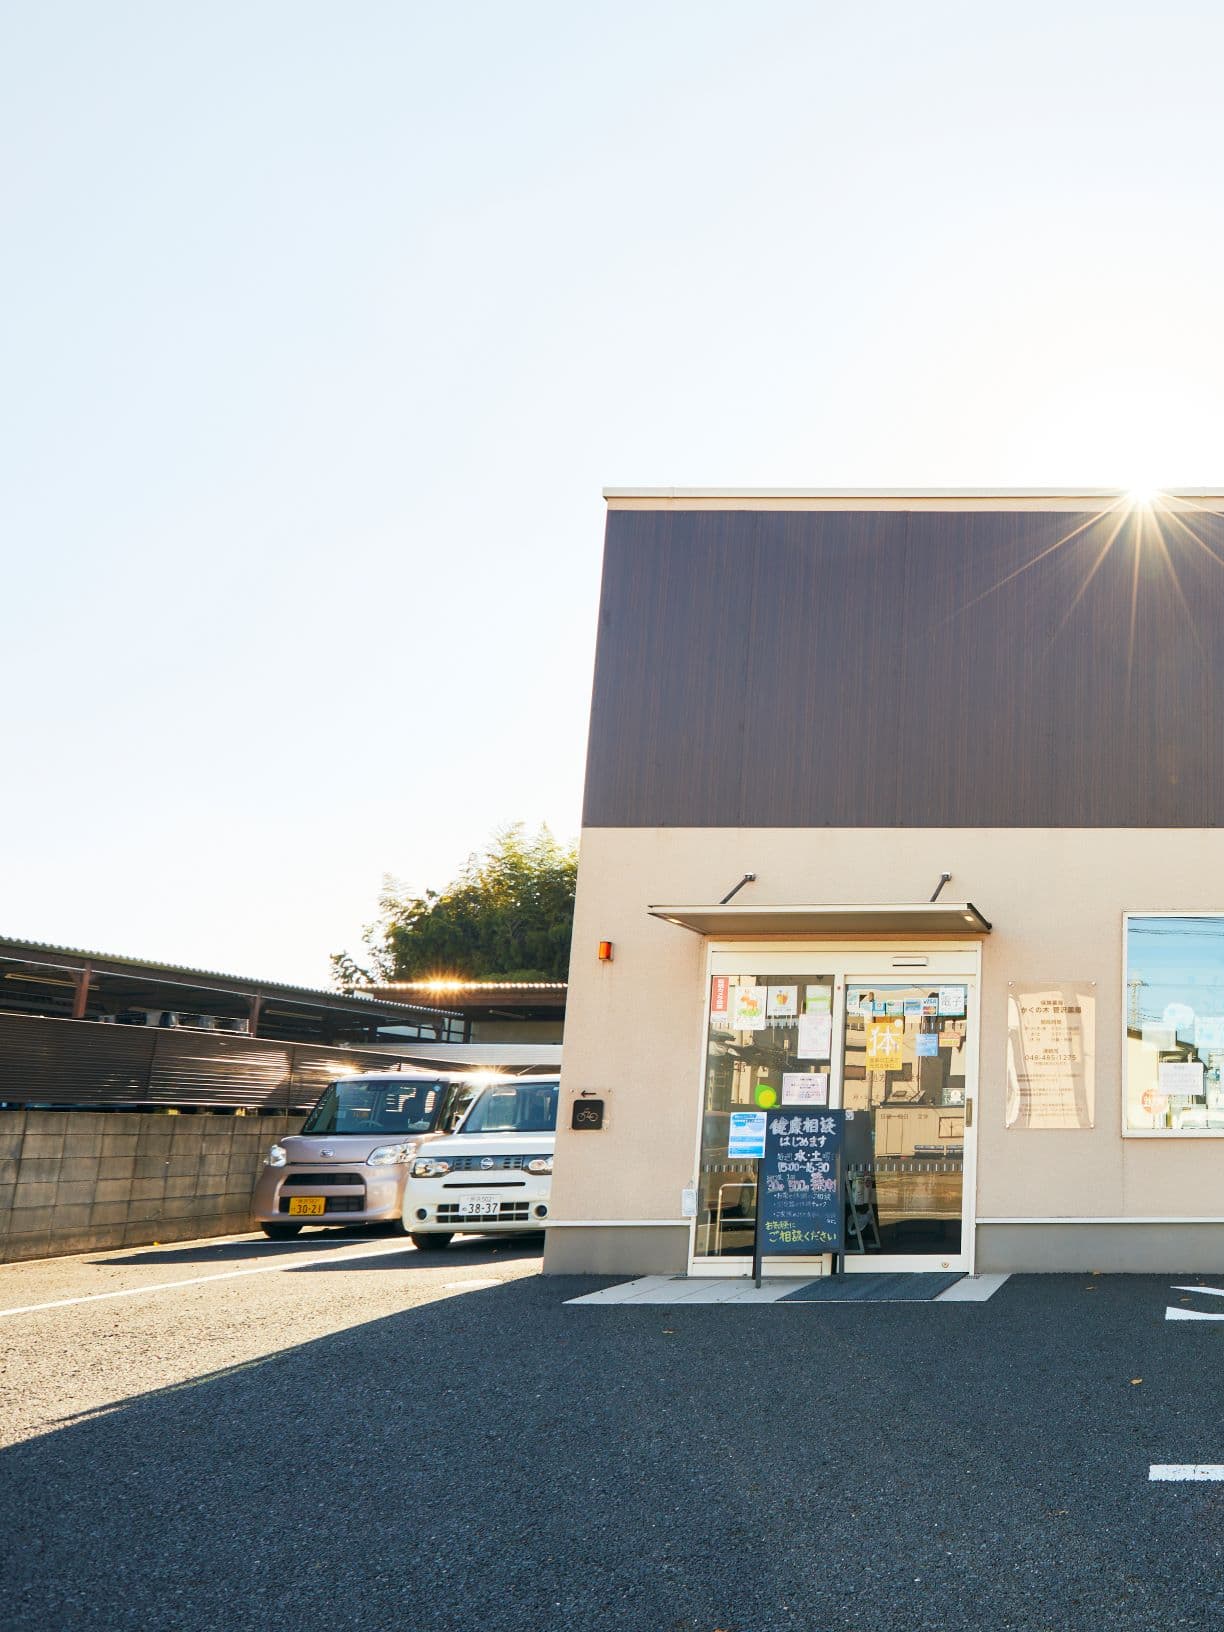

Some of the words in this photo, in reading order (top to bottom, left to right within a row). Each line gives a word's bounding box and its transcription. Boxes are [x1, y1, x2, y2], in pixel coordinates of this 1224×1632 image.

[769, 1116, 836, 1135] 健康相談
[780, 1135, 827, 1148] はじめます
[468, 1203, 498, 1213] 38-37
[769, 1229, 837, 1242] ご相談ください
